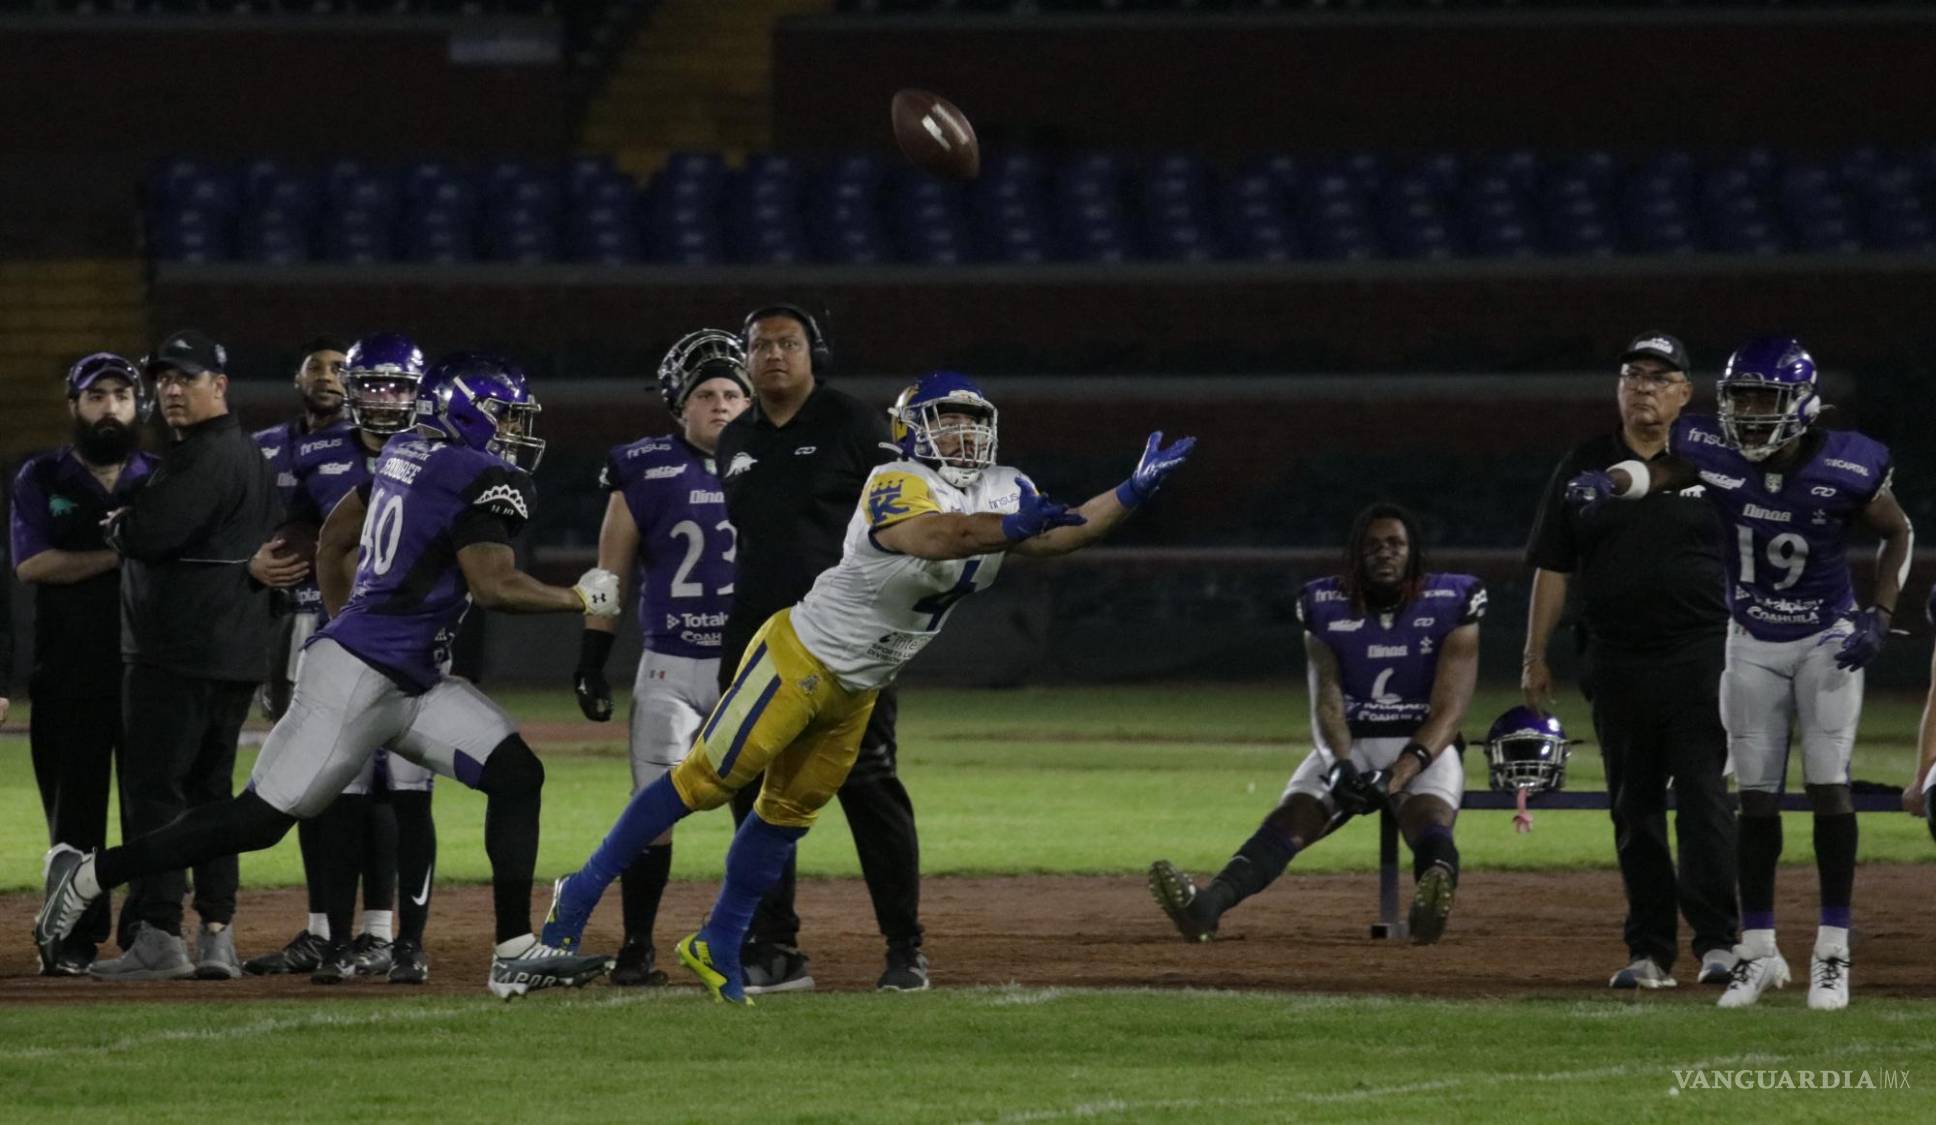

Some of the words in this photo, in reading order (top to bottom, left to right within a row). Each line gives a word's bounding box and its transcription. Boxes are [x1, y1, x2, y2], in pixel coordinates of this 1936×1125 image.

[689, 489, 725, 504] Dino
[669, 519, 738, 598] 23
[1735, 523, 1810, 591] 19
[680, 611, 729, 628] Total
